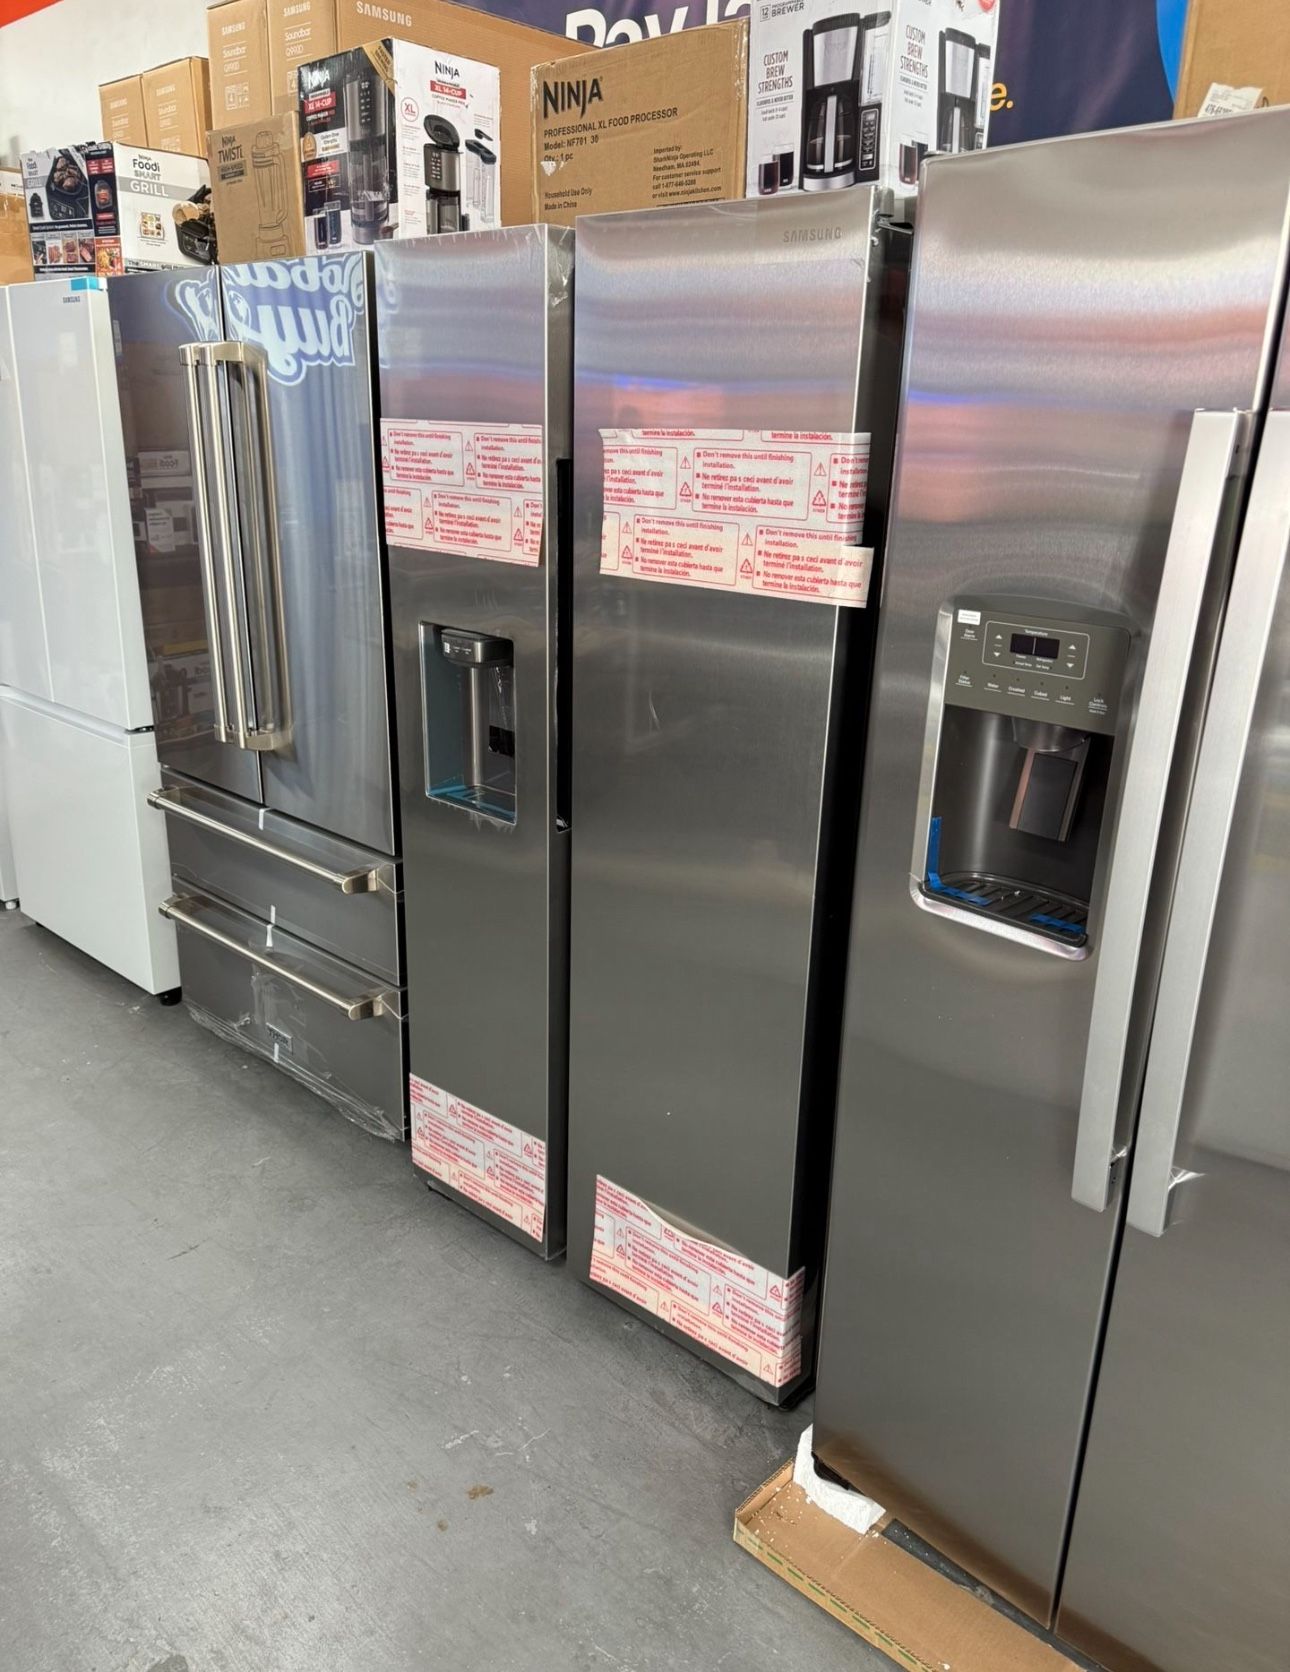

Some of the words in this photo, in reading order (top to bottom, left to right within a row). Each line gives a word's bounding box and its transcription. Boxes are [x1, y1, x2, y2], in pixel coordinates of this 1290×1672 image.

[283, 1, 310, 16] SAMSUNG
[356, 1, 412, 27] SAMSUNG
[762, 8, 769, 16] 12
[772, 3, 804, 17] BREWER
[285, 27, 311, 41] Soundbar
[906, 25, 925, 44] CUSTOM
[764, 50, 788, 66] CUSTOM
[907, 42, 923, 60] BREW
[435, 60, 460, 79] NINJA
[766, 65, 785, 79] BREW
[901, 56, 928, 79] STRENGTHS
[308, 67, 330, 89] NINJA
[758, 76, 793, 94] STRENGTHS
[443, 86, 462, 96] 14-CUP
[543, 78, 603, 118] NINJA
[405, 102, 415, 113] XL
[544, 123, 596, 138] PROFESSIONAL
[608, 116, 628, 128] FOOD
[631, 107, 678, 124] PROCESSOR
[544, 140, 564, 151] Model:
[567, 136, 587, 147] NF701
[591, 135, 599, 144] 30
[654, 146, 673, 154] Imported
[565, 152, 573, 161] pc
[654, 154, 678, 163] SharkNinja
[680, 151, 702, 159] Operating
[132, 158, 160, 172] Foodi
[134, 170, 161, 181] SMART
[662, 172, 683, 180] customer
[130, 181, 168, 197] GRILL
[545, 189, 569, 198] Household
[581, 187, 592, 196] Only
[669, 186, 721, 197] www.ninjakitchen.com
[784, 227, 842, 242] SAMSUNG
